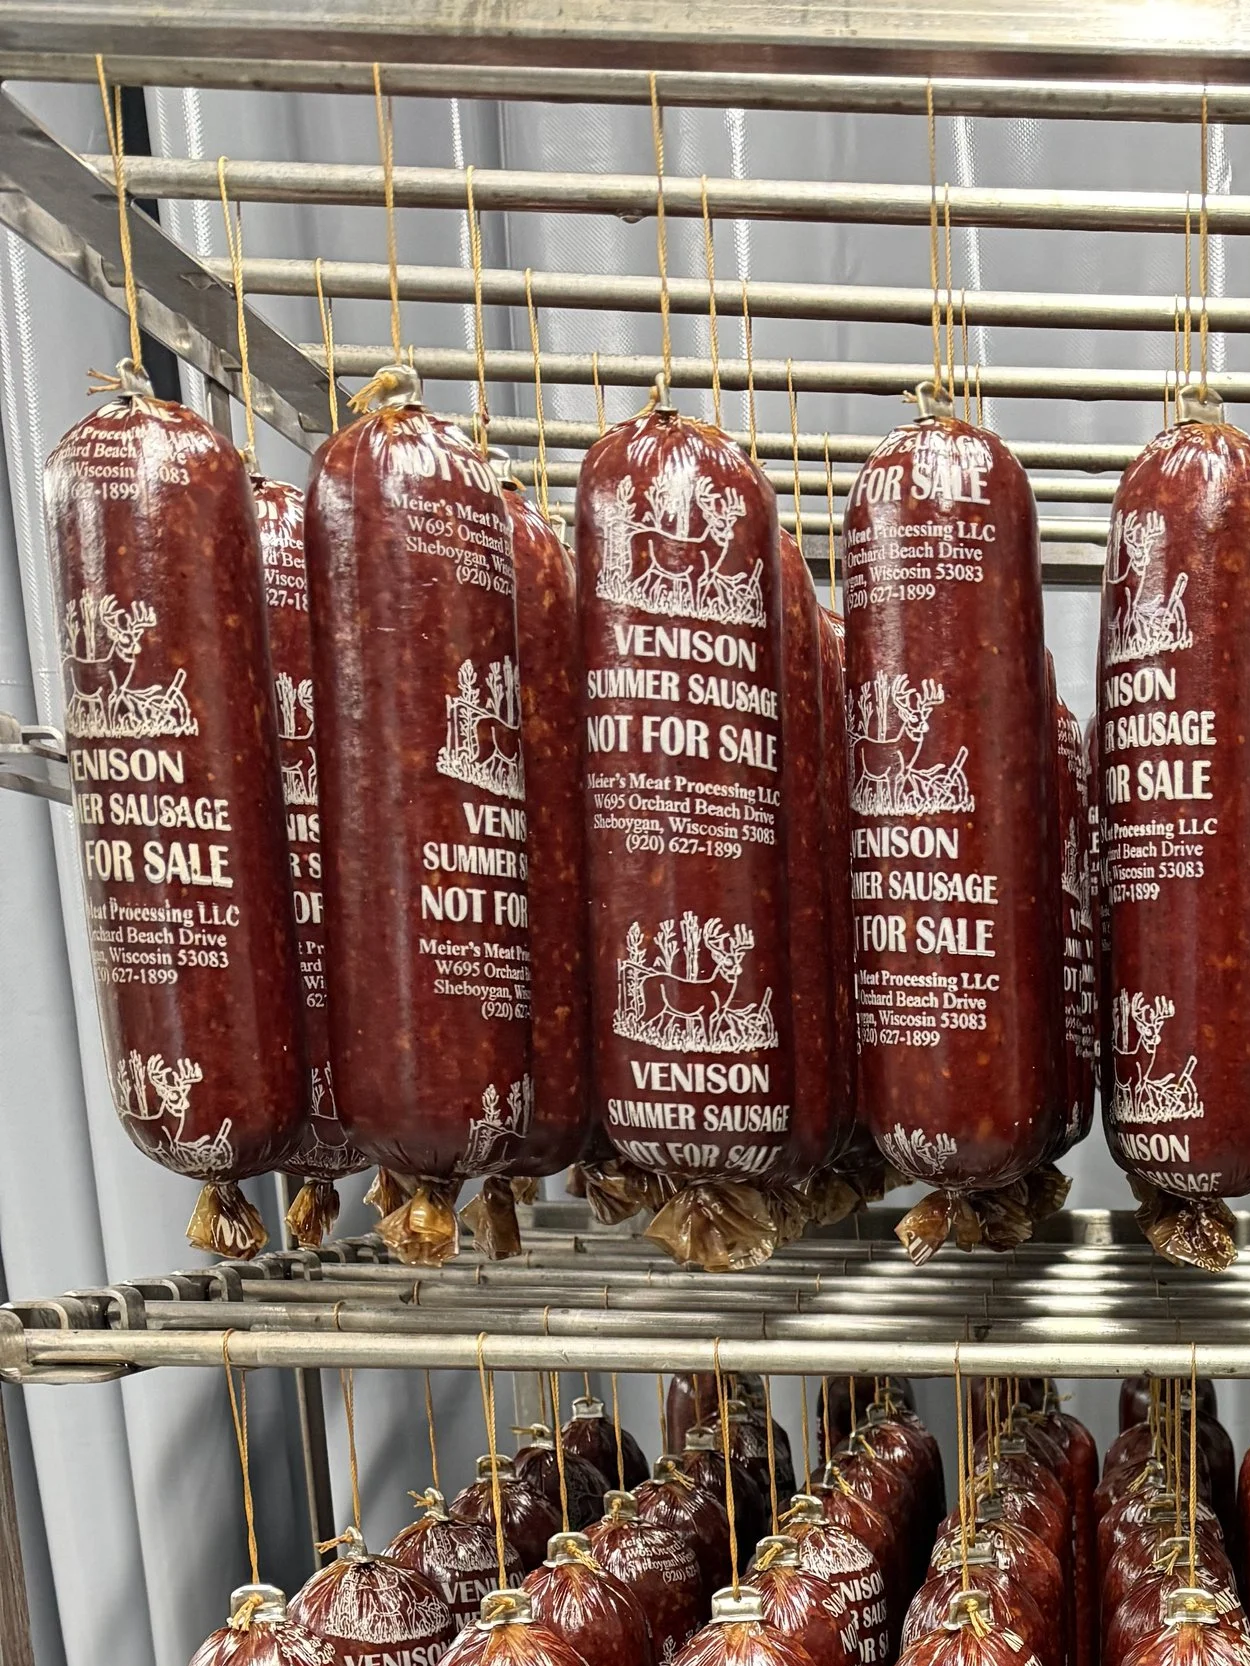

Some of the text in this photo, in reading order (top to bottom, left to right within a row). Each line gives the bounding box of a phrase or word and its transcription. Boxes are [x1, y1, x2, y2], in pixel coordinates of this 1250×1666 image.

[956, 521, 996, 542] LLC
[939, 542, 983, 561] Drive
[935, 563, 984, 583] 53083
[613, 624, 756, 672] VENISON
[588, 669, 779, 721] SUMMER SAUSAGE
[587, 715, 778, 773] NOT FOR SALE
[1117, 711, 1217, 750] SAUSAGE
[629, 773, 671, 791] Meat
[1137, 760, 1214, 801] SALE
[110, 793, 232, 831] SAUSAGE
[628, 793, 741, 820] Orchard Beach
[1178, 818, 1218, 835] LLC
[422, 841, 517, 878] SUMMER
[625, 833, 742, 860] (920) 627-1899
[1161, 841, 1204, 857] Drive
[143, 841, 234, 888] SALE
[1158, 861, 1204, 878] 53083
[888, 871, 999, 905] SAUSAGE
[109, 898, 240, 927] Processing LLC
[420, 884, 487, 923] NOT
[127, 927, 227, 946] Beach Drive
[863, 915, 996, 957] FOR SALE
[109, 947, 229, 968] Wiscosin 53083
[434, 959, 481, 977] W695
[112, 968, 178, 985] 627-1899
[881, 970, 1000, 991] Processing LLC
[896, 991, 987, 1010] Beach Drive
[940, 1012, 987, 1031] 53083
[879, 1031, 941, 1047] 627-1899
[630, 1060, 770, 1095] VENISON
[608, 1098, 790, 1133] SUMMER SAUSAGE
